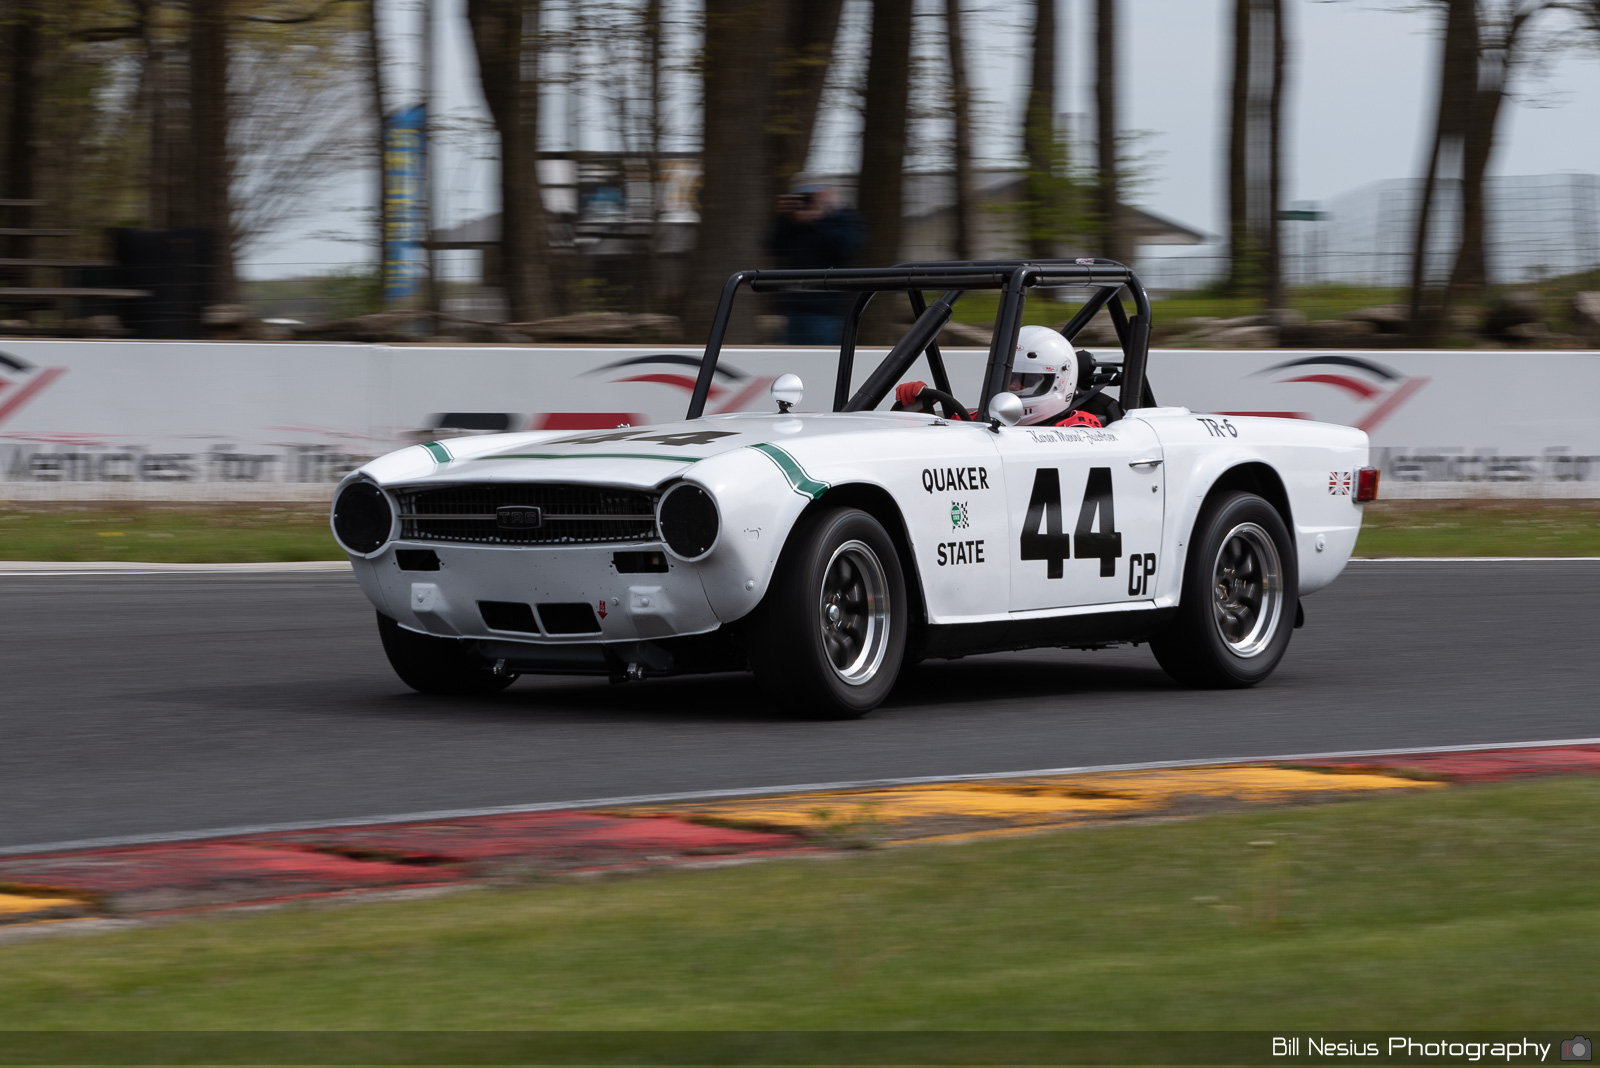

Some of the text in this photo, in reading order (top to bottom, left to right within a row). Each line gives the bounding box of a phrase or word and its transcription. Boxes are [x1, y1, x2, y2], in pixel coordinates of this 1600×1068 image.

[1197, 418, 1238, 438] TR-6
[922, 467, 990, 493] QUAKER
[498, 511, 536, 524] TR6
[1020, 467, 1122, 579] 44
[937, 541, 985, 566] STATE
[1128, 553, 1156, 596] CP
